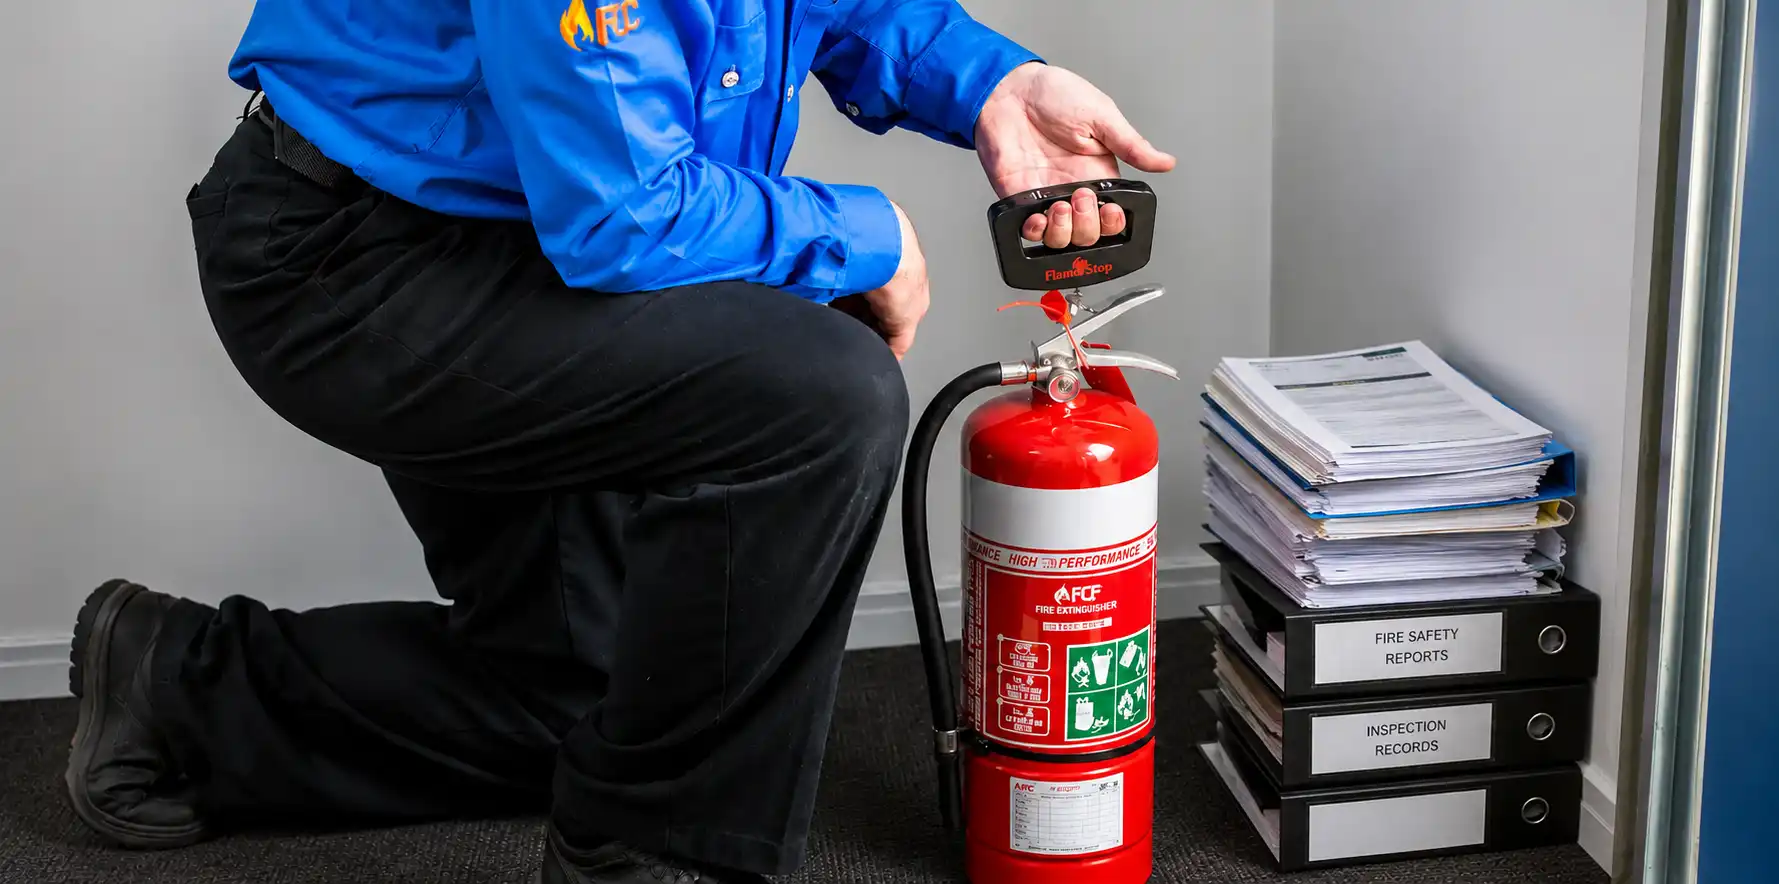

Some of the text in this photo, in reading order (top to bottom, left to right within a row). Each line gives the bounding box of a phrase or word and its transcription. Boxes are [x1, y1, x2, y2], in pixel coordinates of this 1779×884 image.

[1085, 263, 1113, 275] Stop
[1009, 553, 1038, 567] HIGH
[1058, 543, 1140, 569] PERFORMANCE
[1035, 600, 1117, 615] FIRE EXTINGUISHER
[1375, 628, 1459, 644] FIRE SAFETY
[1385, 649, 1449, 664] REPORTS
[1367, 720, 1447, 737] INSPECTION
[1375, 740, 1439, 756] RECORDS
